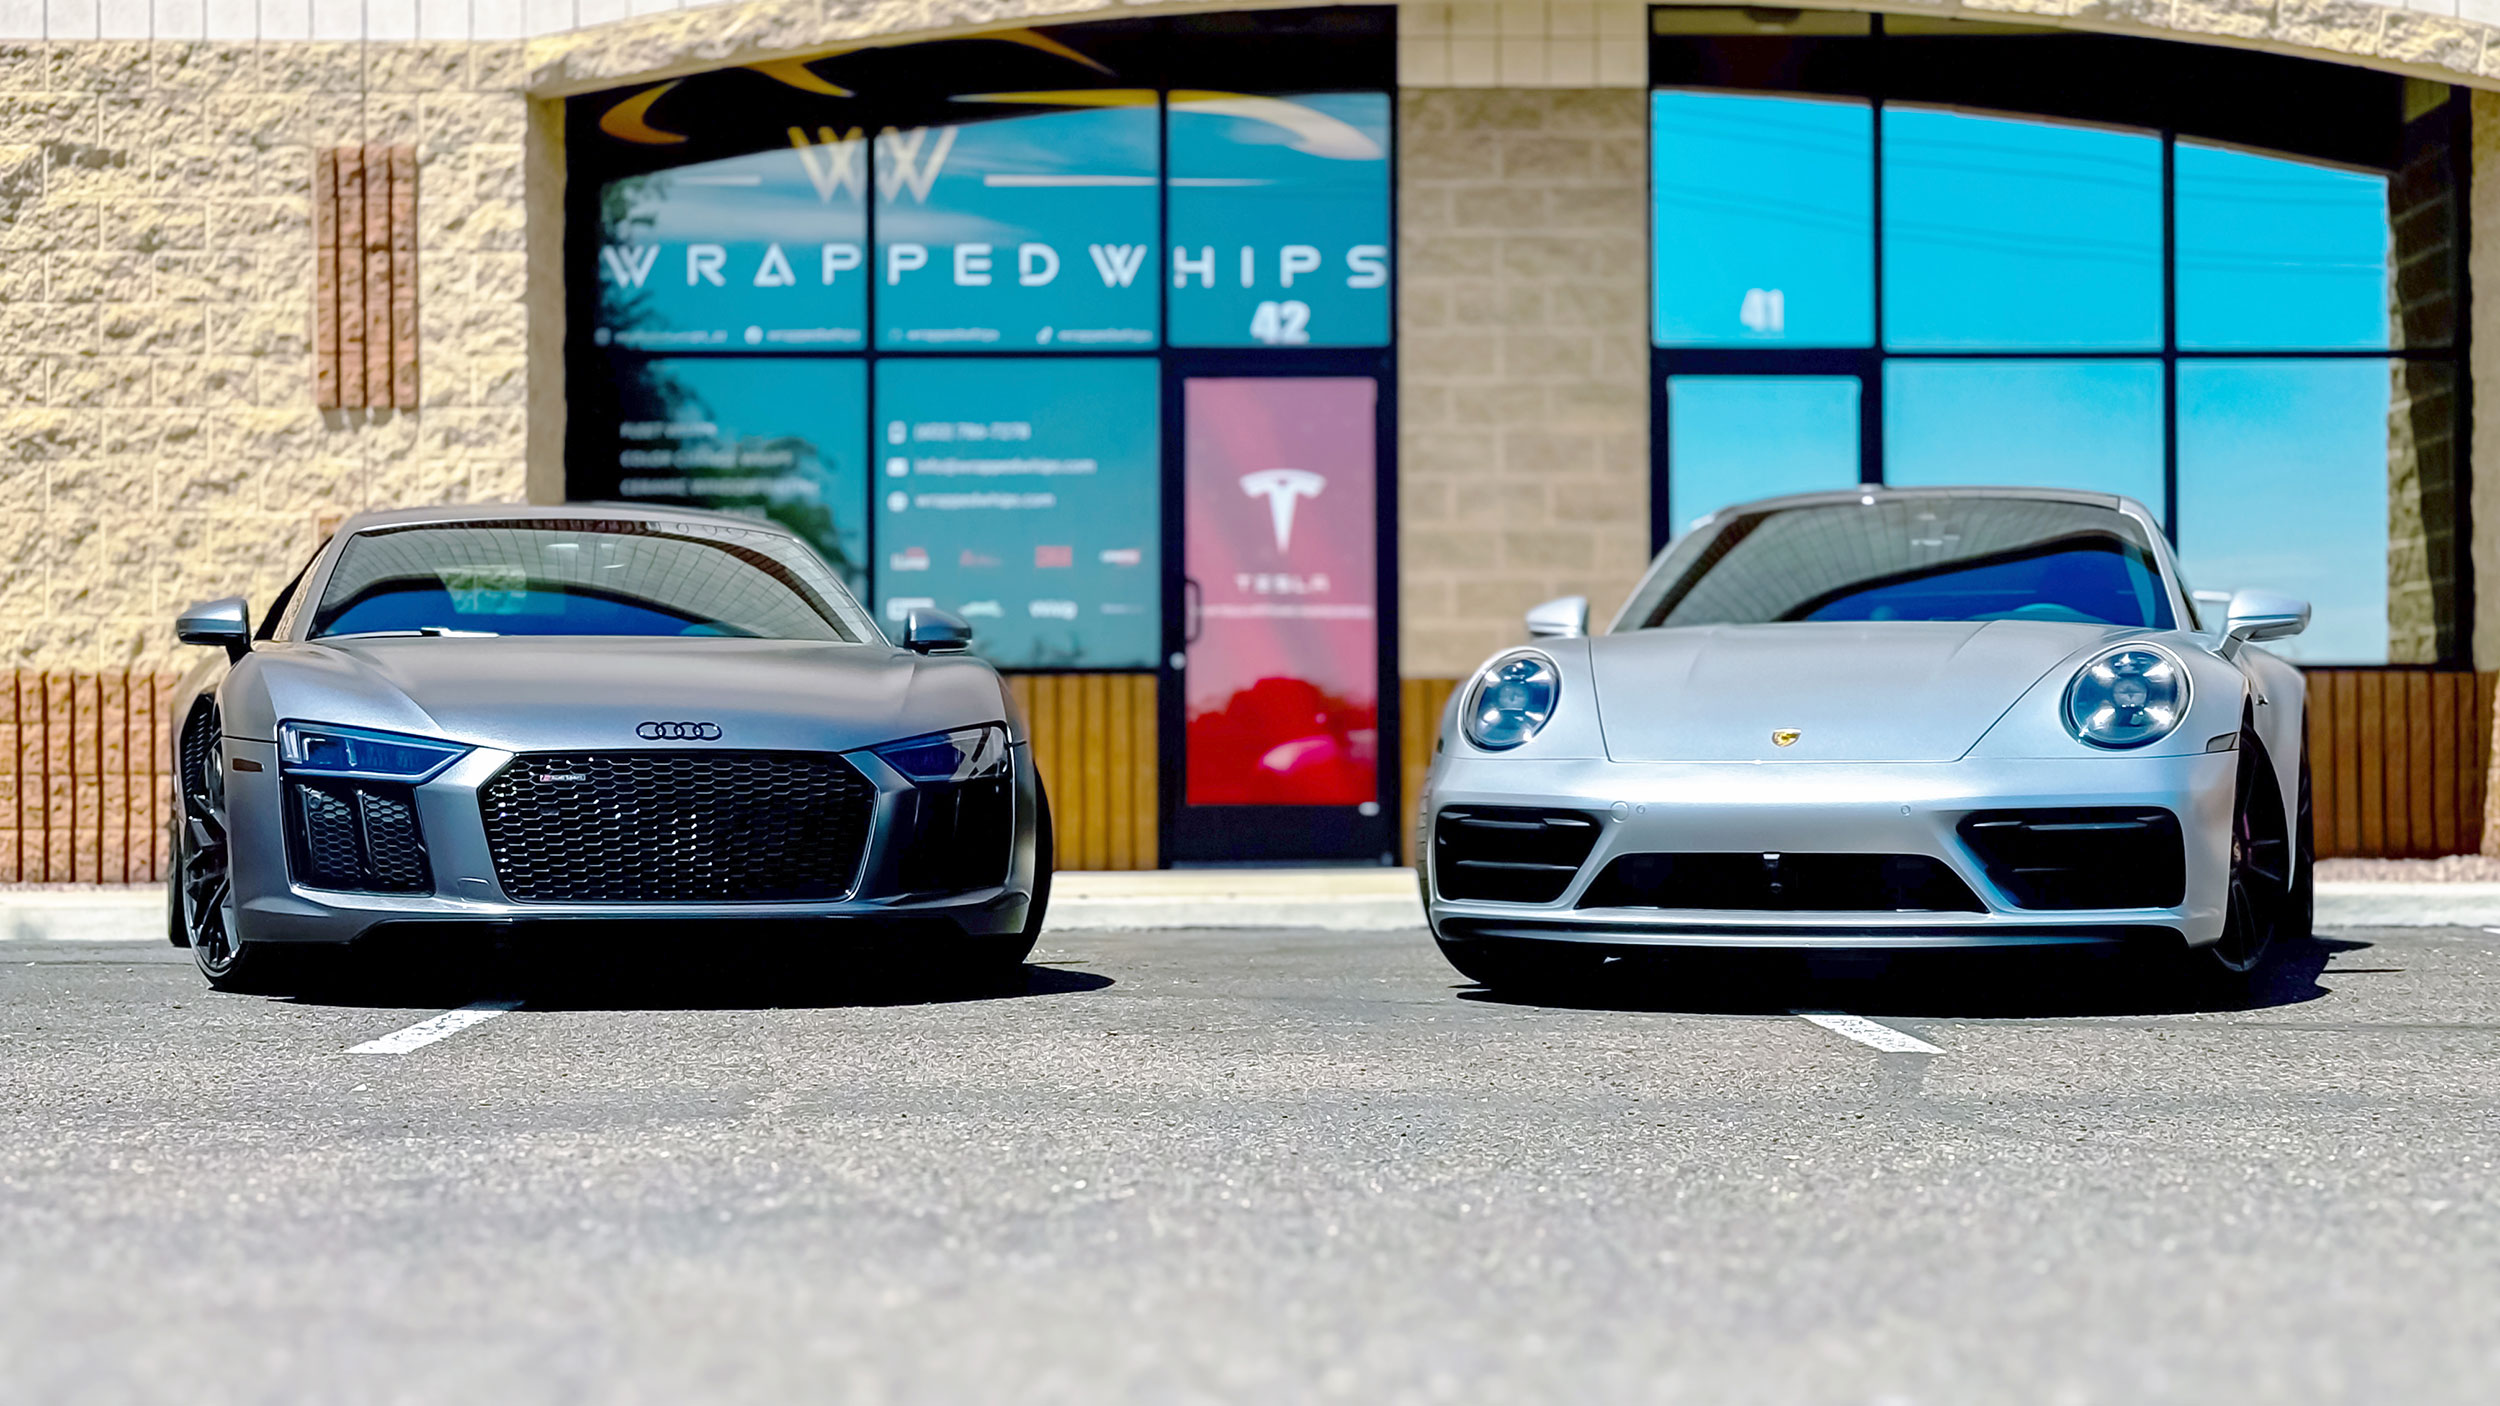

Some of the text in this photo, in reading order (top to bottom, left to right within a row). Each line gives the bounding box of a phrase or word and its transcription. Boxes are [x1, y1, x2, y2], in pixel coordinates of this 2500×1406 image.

[600, 242, 1388, 289] WRAPPED WHIPS
[1249, 300, 1311, 345] 42
[1740, 287, 1784, 332] 41
[1235, 573, 1330, 595] TESLA
